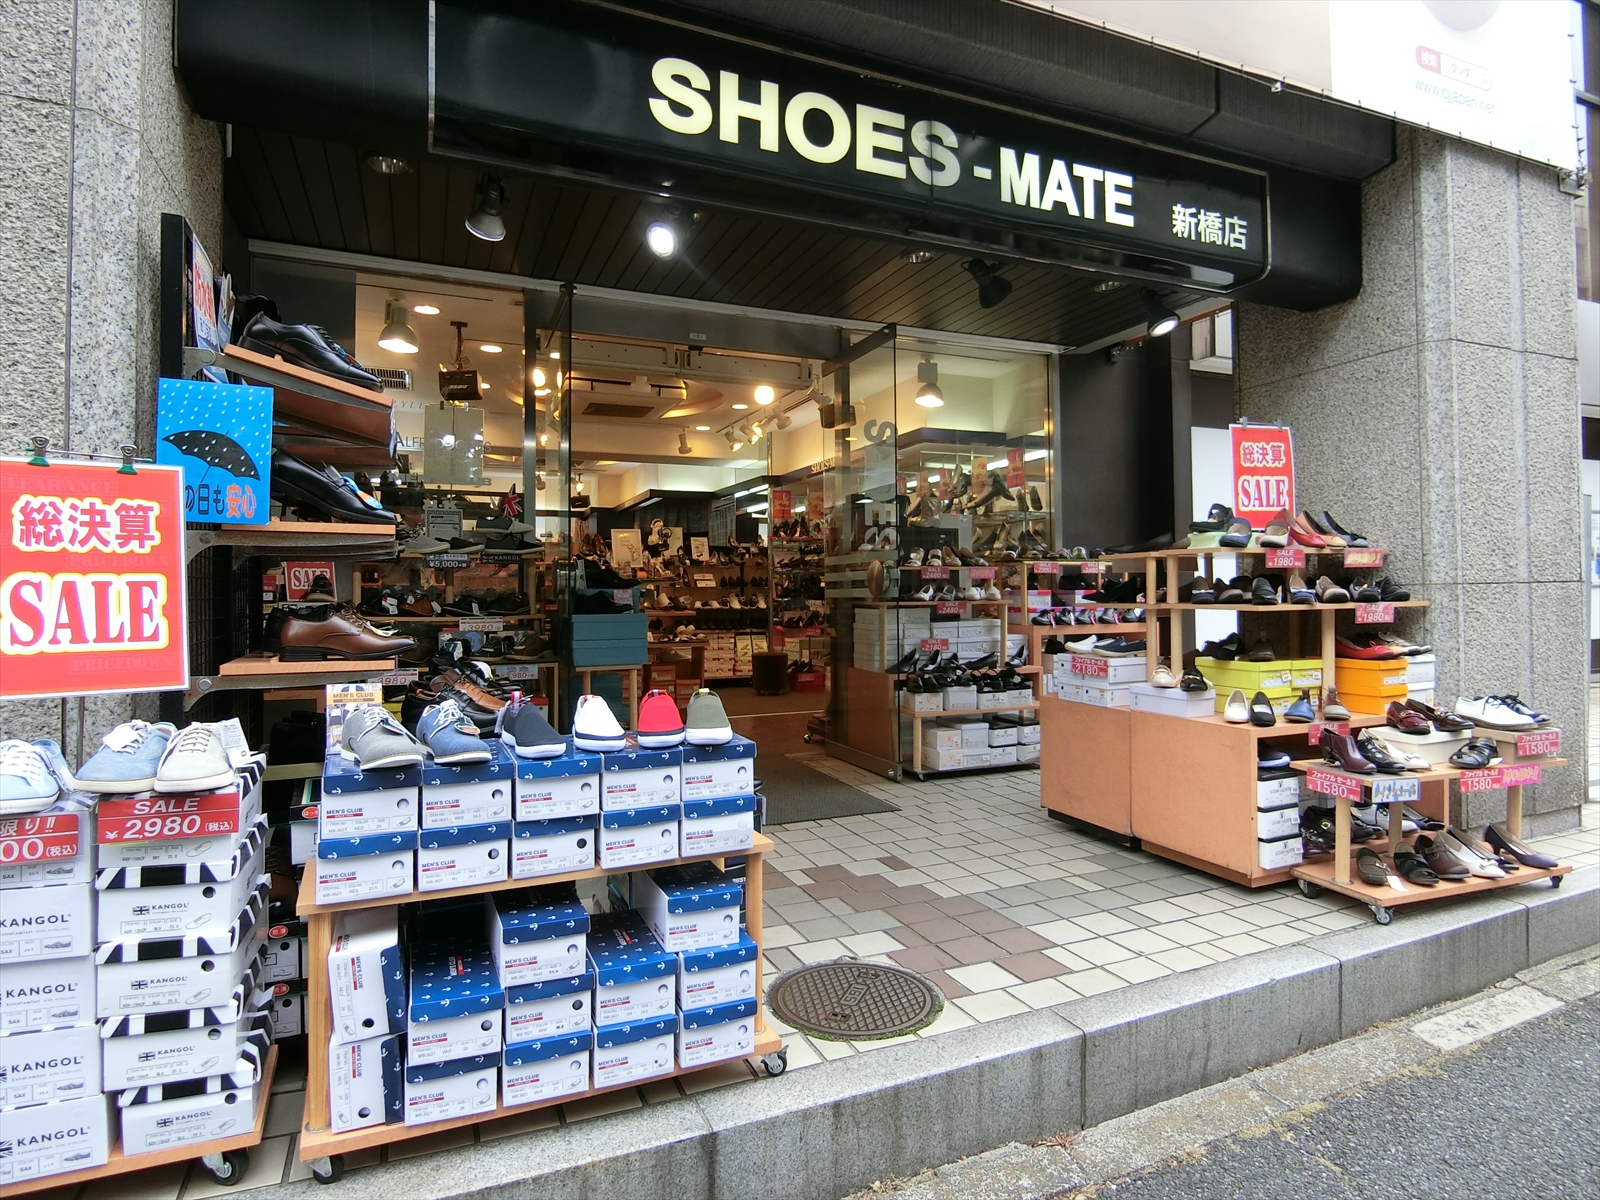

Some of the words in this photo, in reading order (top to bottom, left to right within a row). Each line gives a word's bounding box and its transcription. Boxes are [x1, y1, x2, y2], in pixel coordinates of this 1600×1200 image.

[1171, 203, 1247, 250] 新橋店
[1242, 445, 1283, 464] 総決算
[1241, 479, 1286, 507] SALE
[19, 500, 155, 549] 総決算
[9, 580, 160, 647] SALE
[1311, 771, 1335, 781] ファイナル
[133, 798, 200, 814] SALE
[0, 914, 69, 927] KANGOL
[6, 983, 76, 998] KANGOL
[528, 1011, 543, 1019] CLUB
[158, 1046, 194, 1055] KANGOL
[11, 1056, 82, 1073] KANGOL
[507, 1076, 524, 1084] MEN'S
[525, 1073, 540, 1081] CLUB
[409, 1094, 427, 1102] MEN'S
[175, 1111, 211, 1121] KANGOL
[17, 1127, 88, 1147] KANGOL
